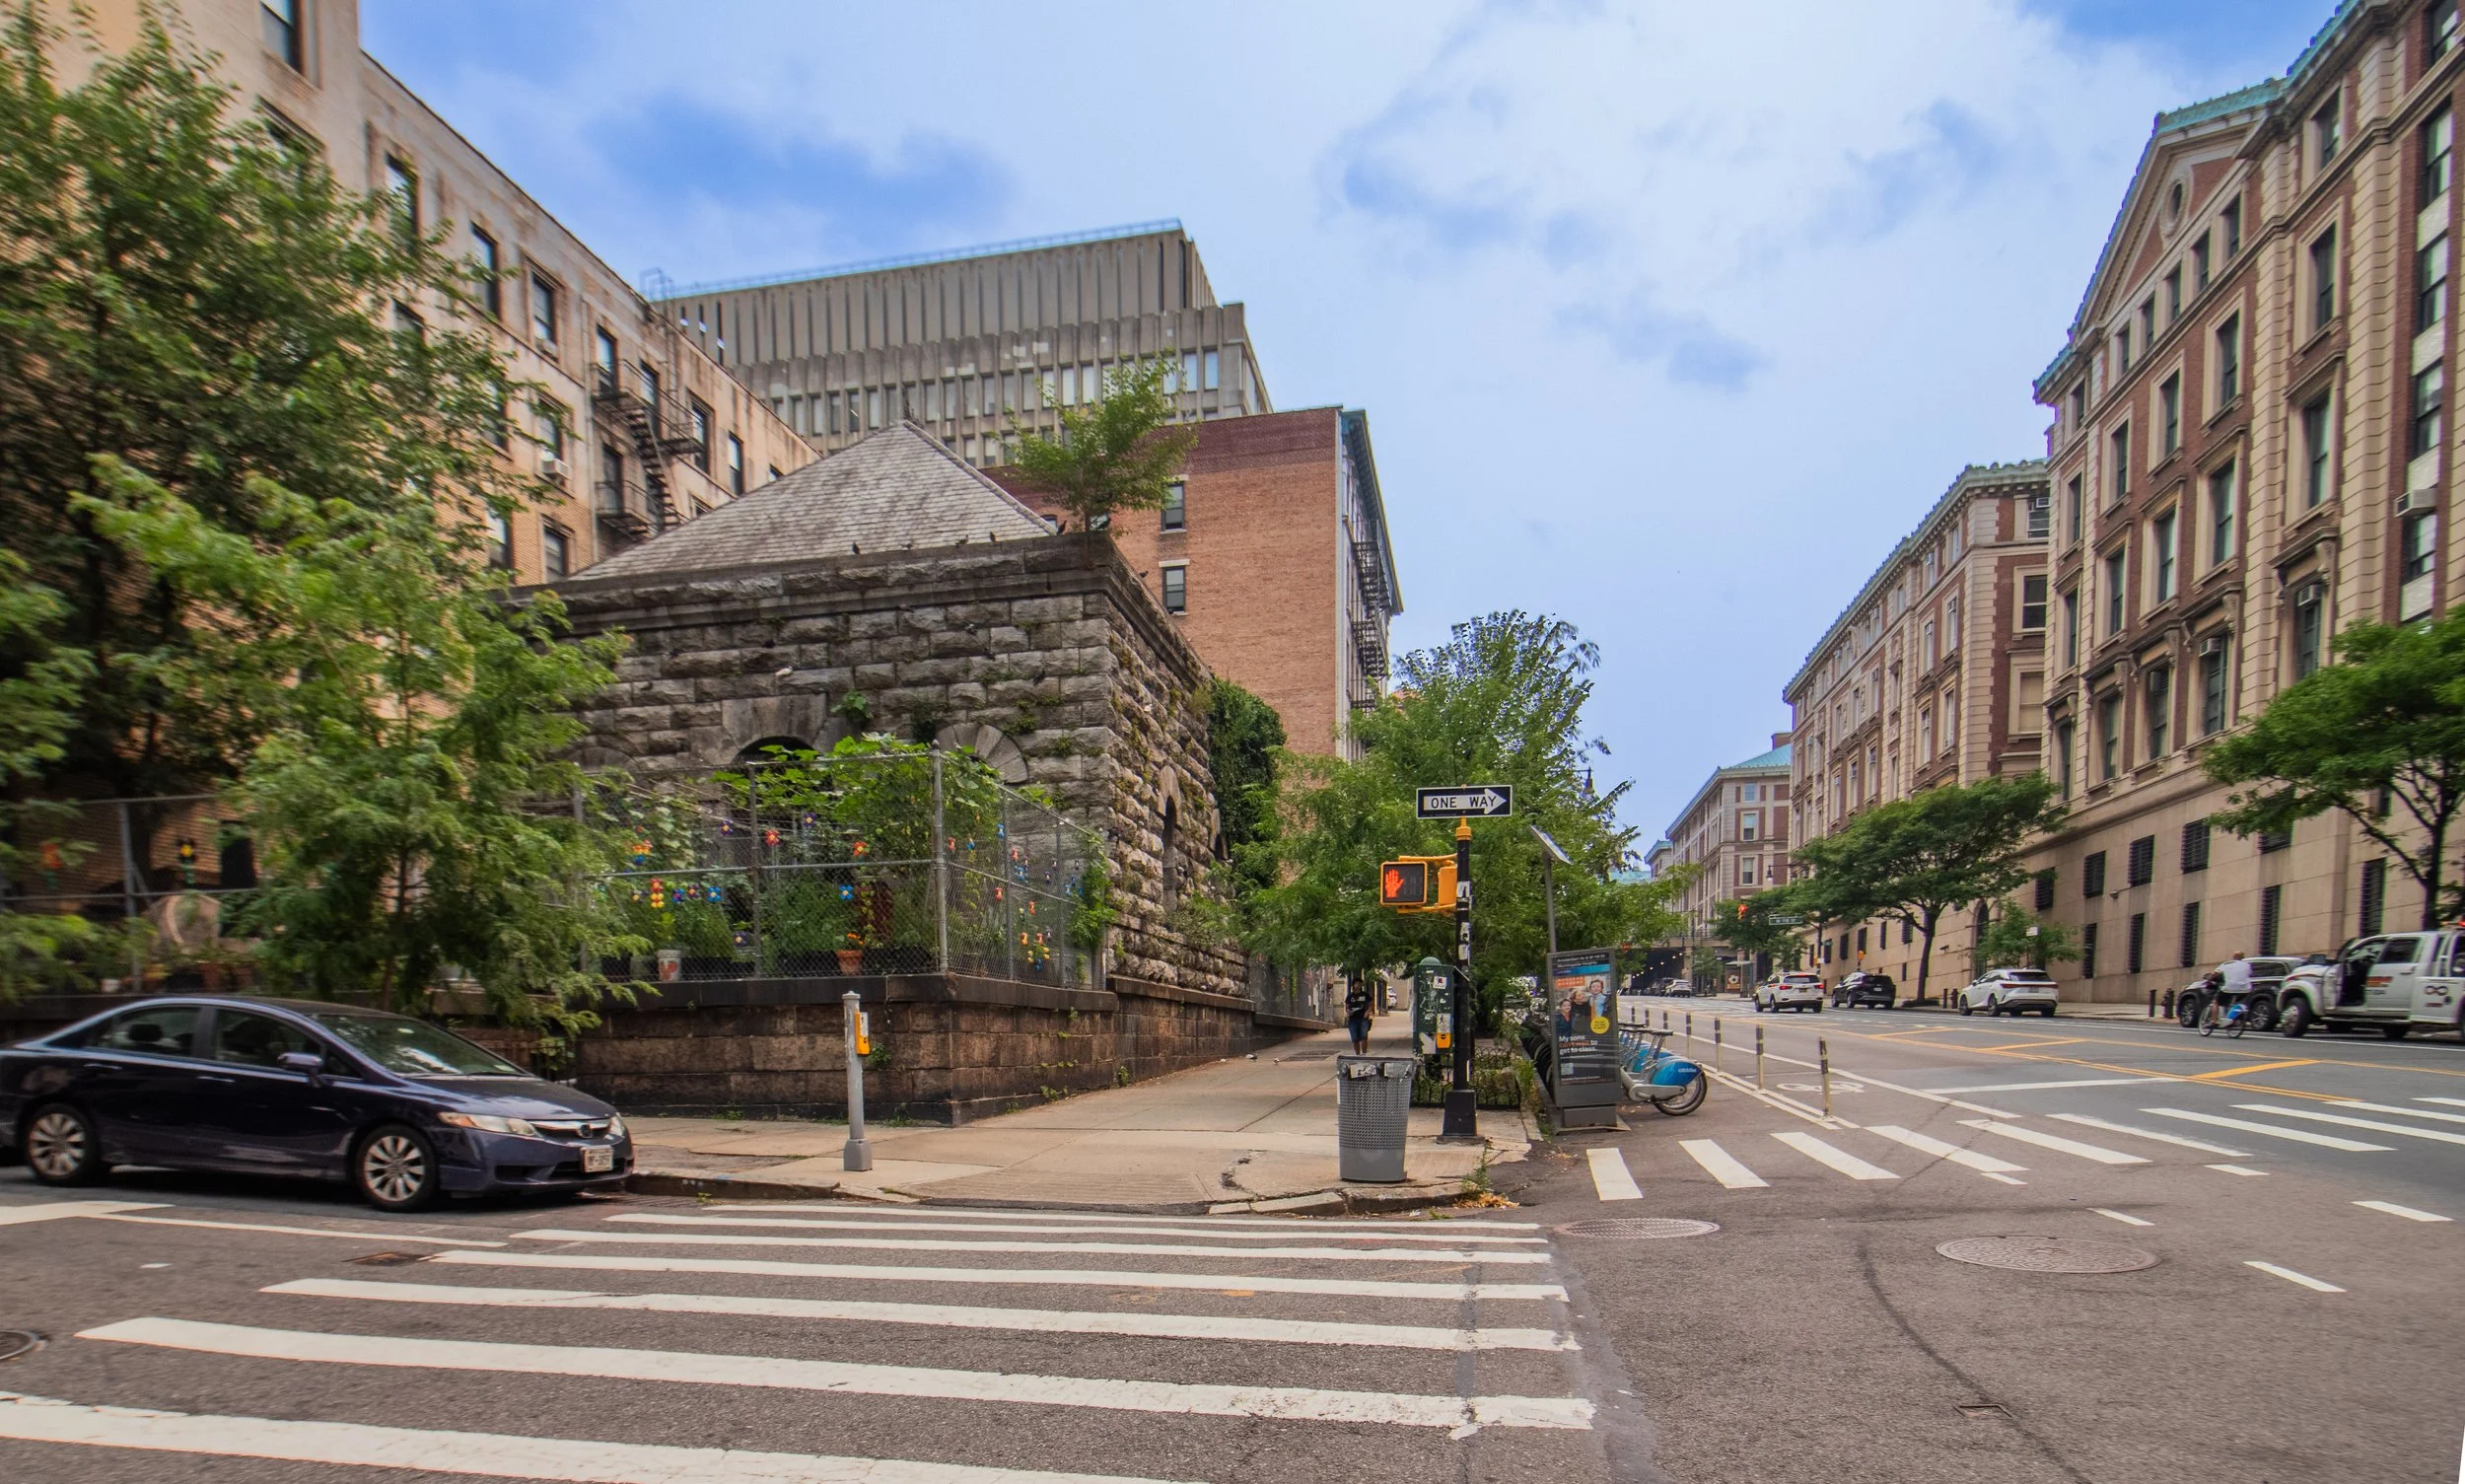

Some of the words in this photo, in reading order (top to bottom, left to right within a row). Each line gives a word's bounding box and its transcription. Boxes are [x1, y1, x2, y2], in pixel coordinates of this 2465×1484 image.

[1431, 797, 1457, 809] ONE
[1469, 796, 1497, 808] WAY
[1559, 1047, 1571, 1056] get
